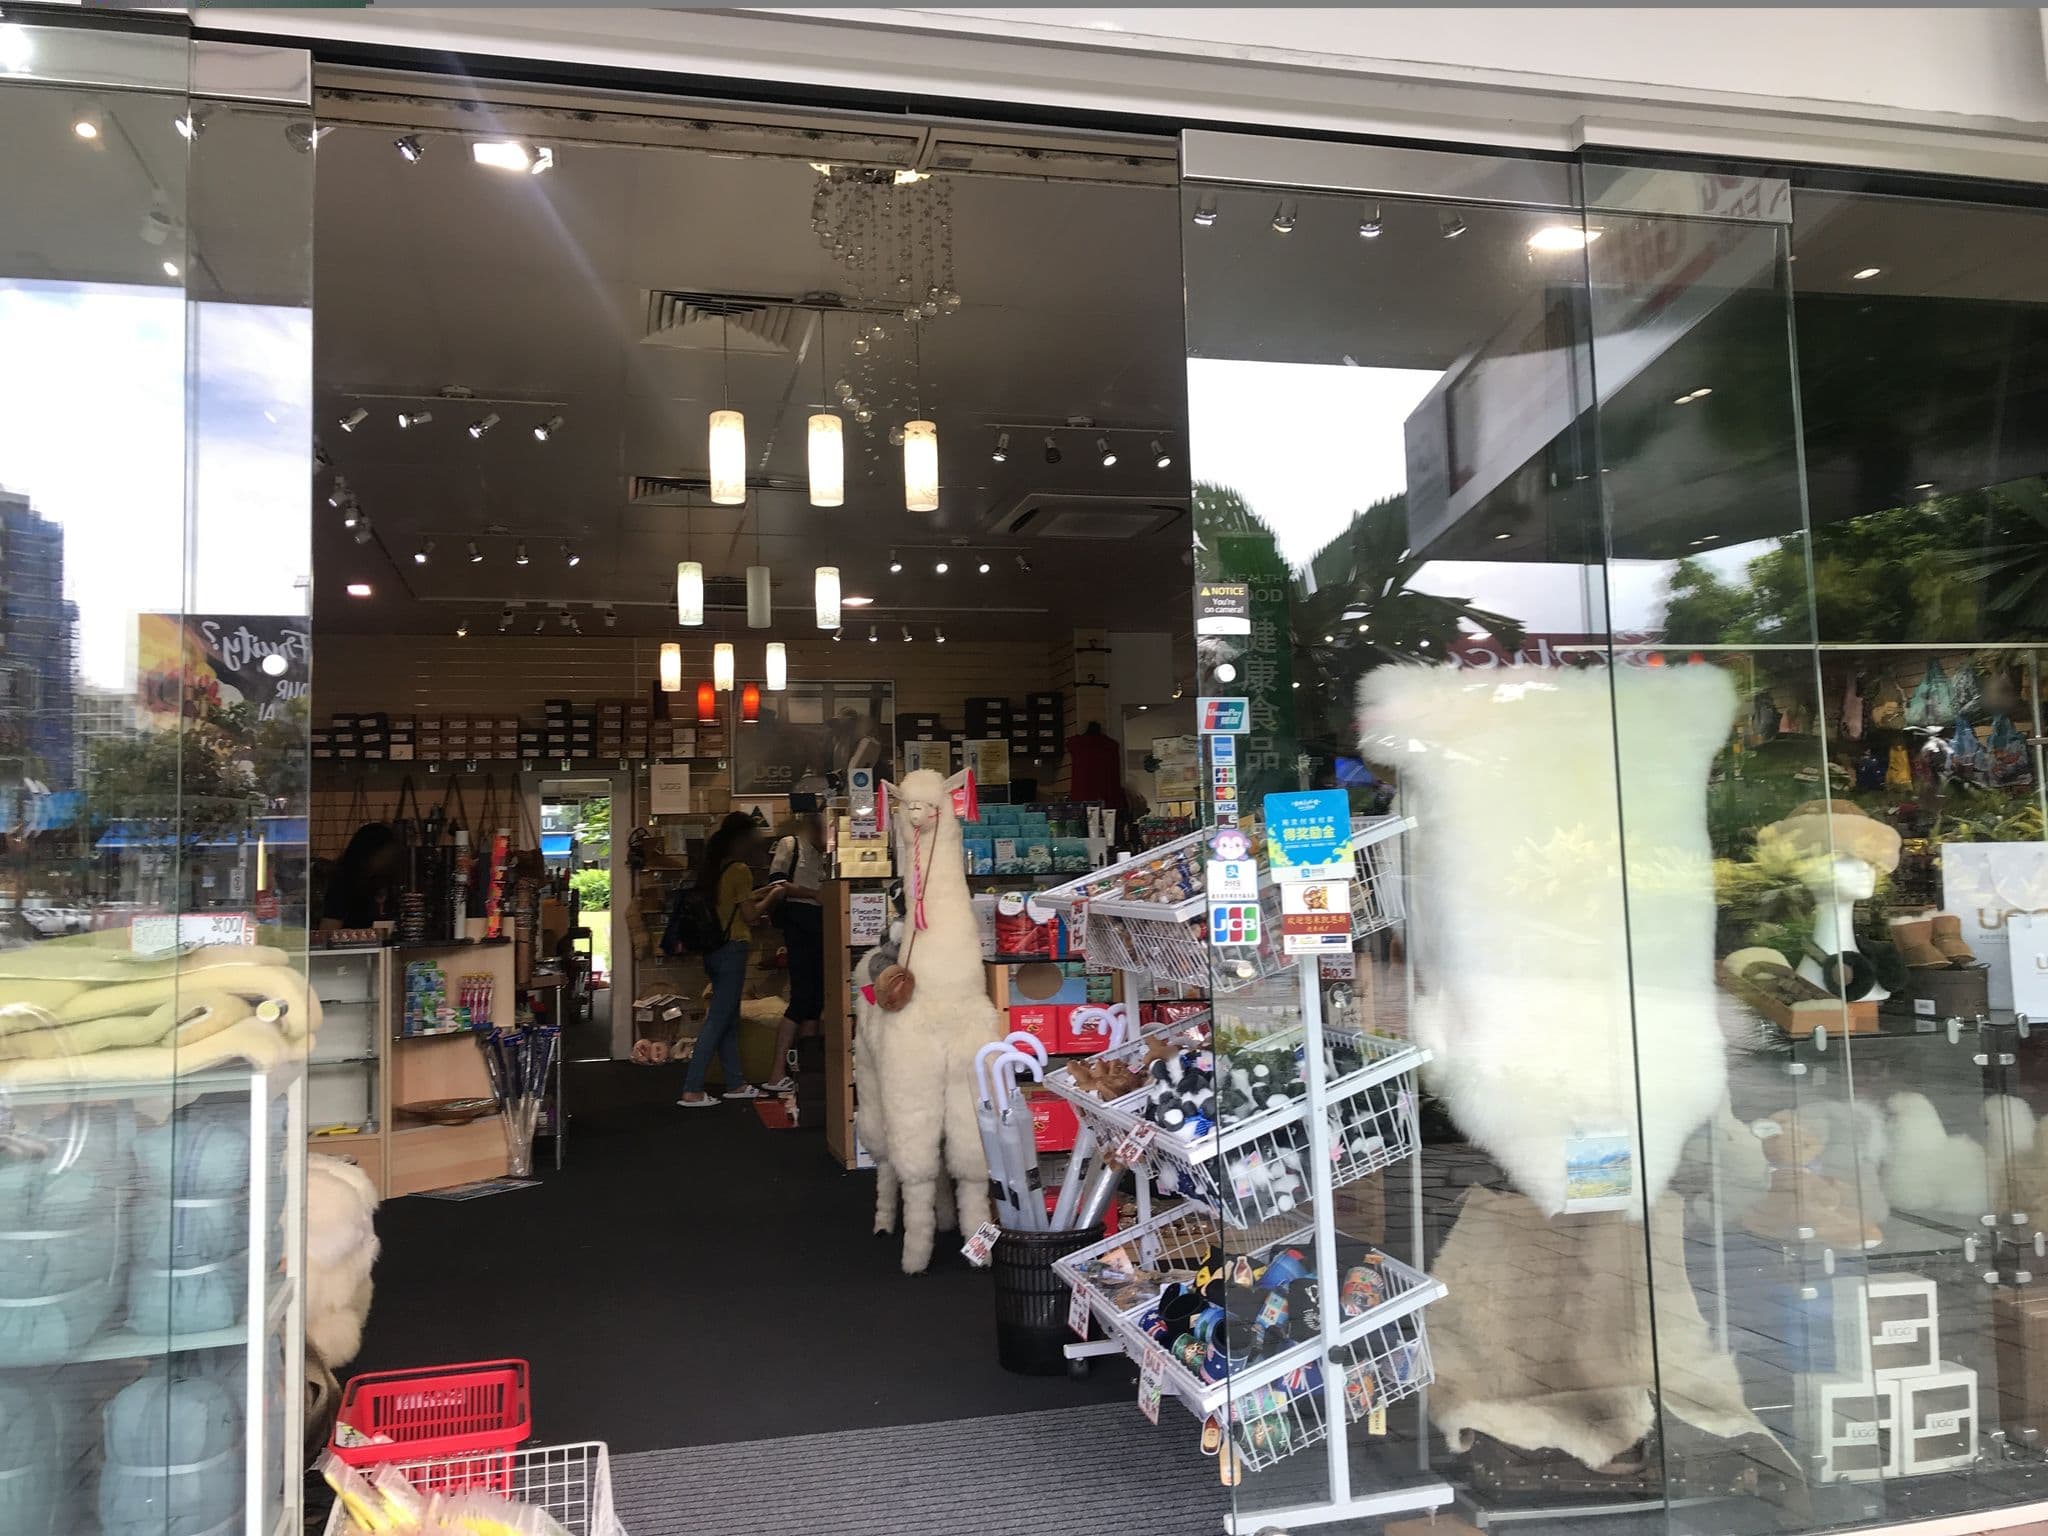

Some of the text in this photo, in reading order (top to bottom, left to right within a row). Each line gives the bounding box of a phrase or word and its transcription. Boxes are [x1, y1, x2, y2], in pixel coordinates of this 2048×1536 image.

[1211, 587, 1245, 596] NOTICE
[1212, 598, 1237, 606] You're
[1215, 606, 1244, 614] camera!
[1218, 803, 1237, 811] VISA
[1887, 1326, 1912, 1337] UGG
[1931, 1417, 1955, 1429] UGG
[1851, 1428, 1876, 1438] UGG
